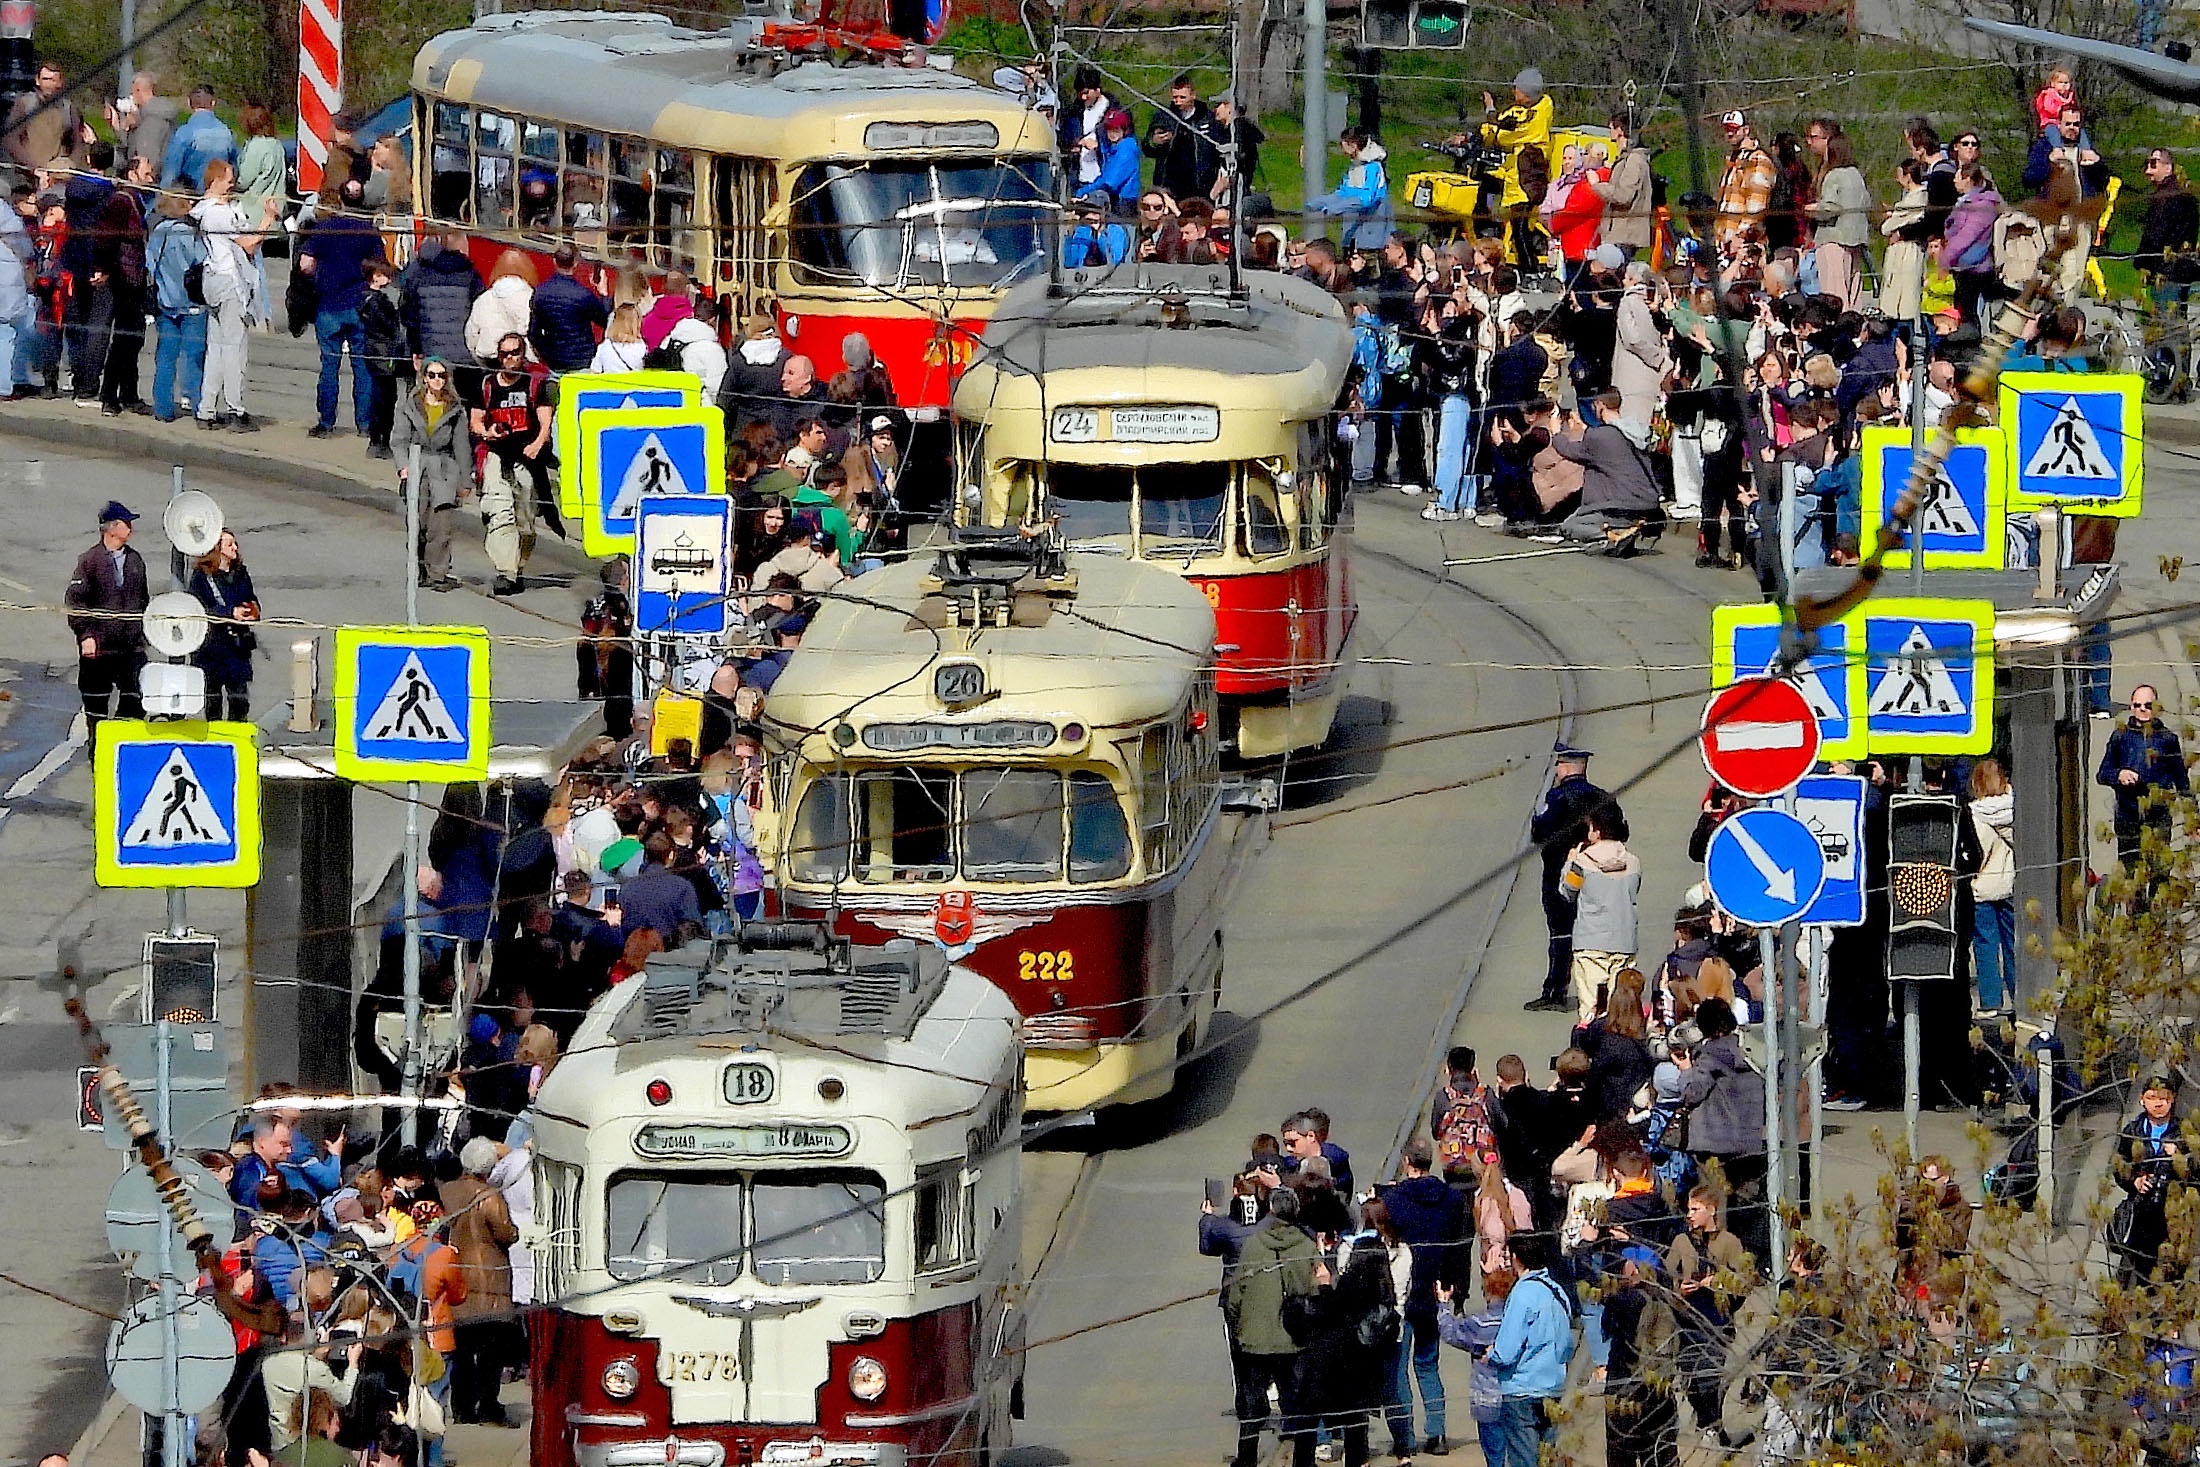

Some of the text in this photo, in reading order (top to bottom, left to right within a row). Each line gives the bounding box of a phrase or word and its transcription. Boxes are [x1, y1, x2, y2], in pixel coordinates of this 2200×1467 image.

[1058, 411, 1093, 435] 24
[944, 671, 978, 697] 26
[1018, 951, 1074, 981] 222
[736, 1069, 765, 1098] 18
[665, 1351, 737, 1381] 1278
